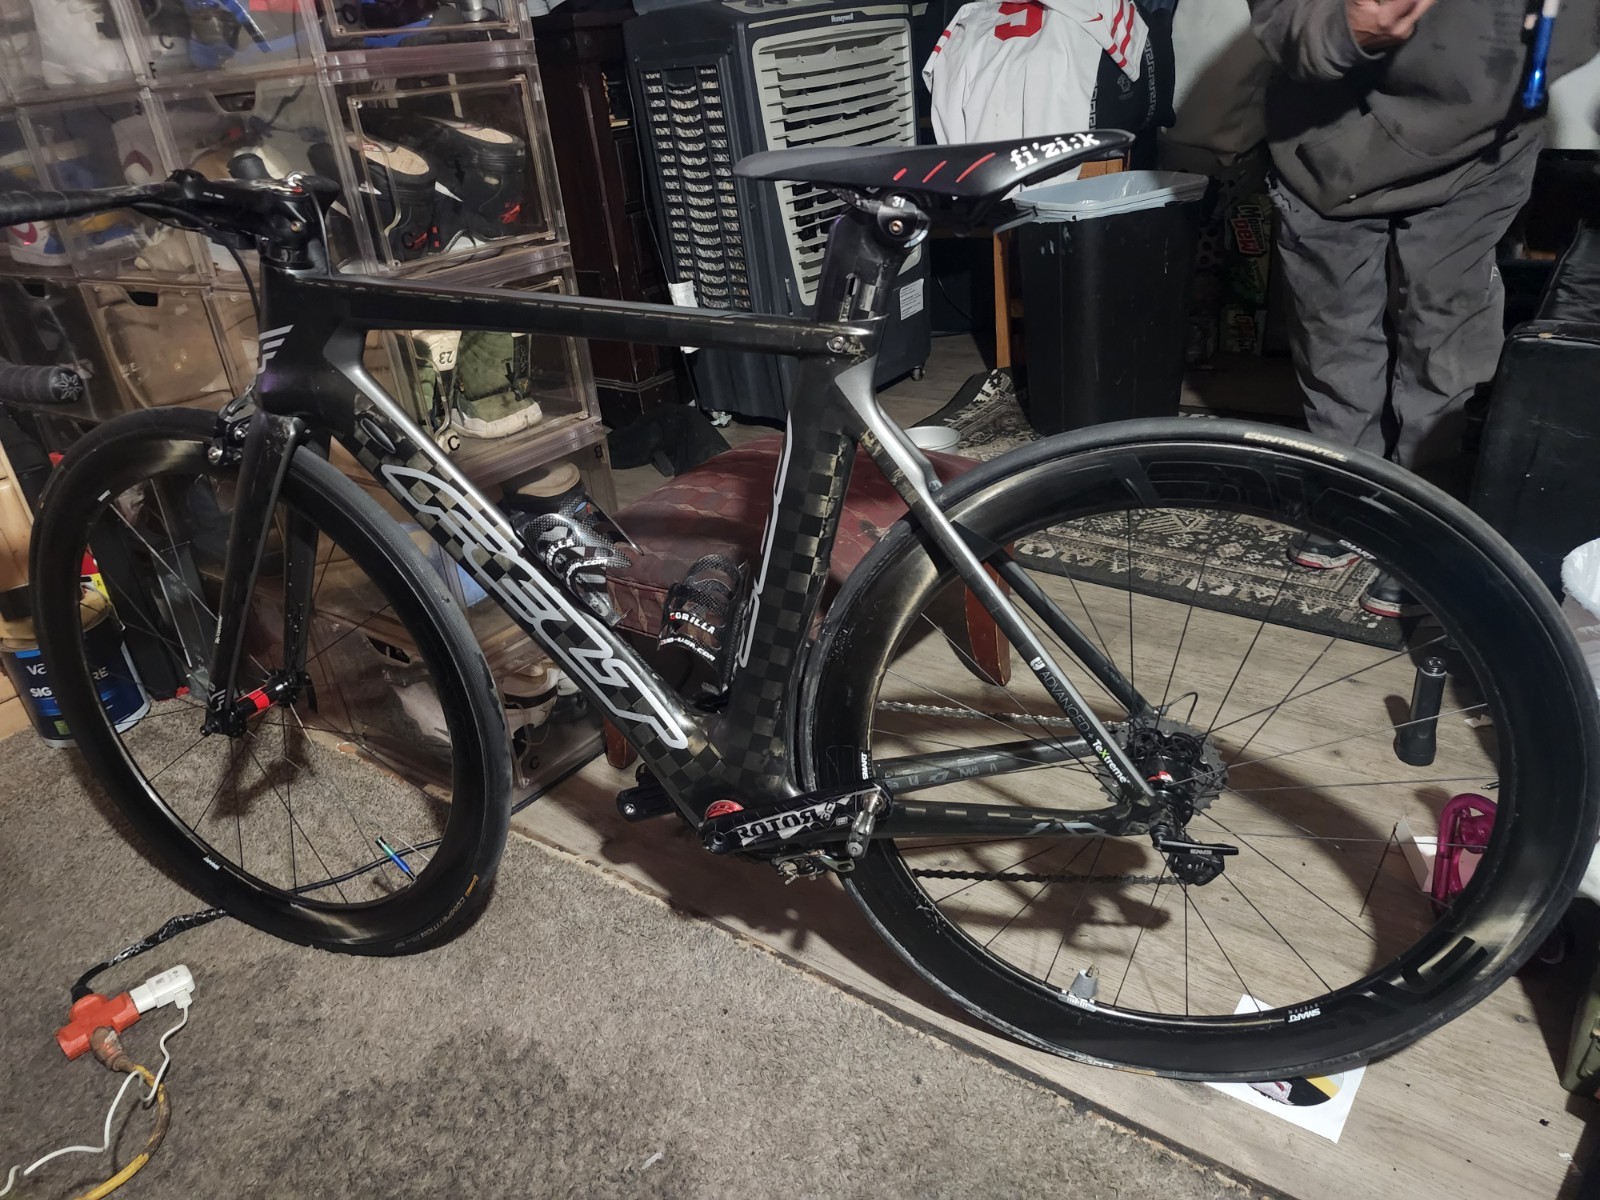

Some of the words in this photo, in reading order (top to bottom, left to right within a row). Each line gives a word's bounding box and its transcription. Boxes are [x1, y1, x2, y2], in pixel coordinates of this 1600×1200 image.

[830, 12, 854, 24] Honeywell
[669, 611, 716, 635] GORILLA
[1040, 671, 1091, 732] ADVANCED
[861, 752, 869, 780] SMART
[1287, 1007, 1321, 1023] SMART
